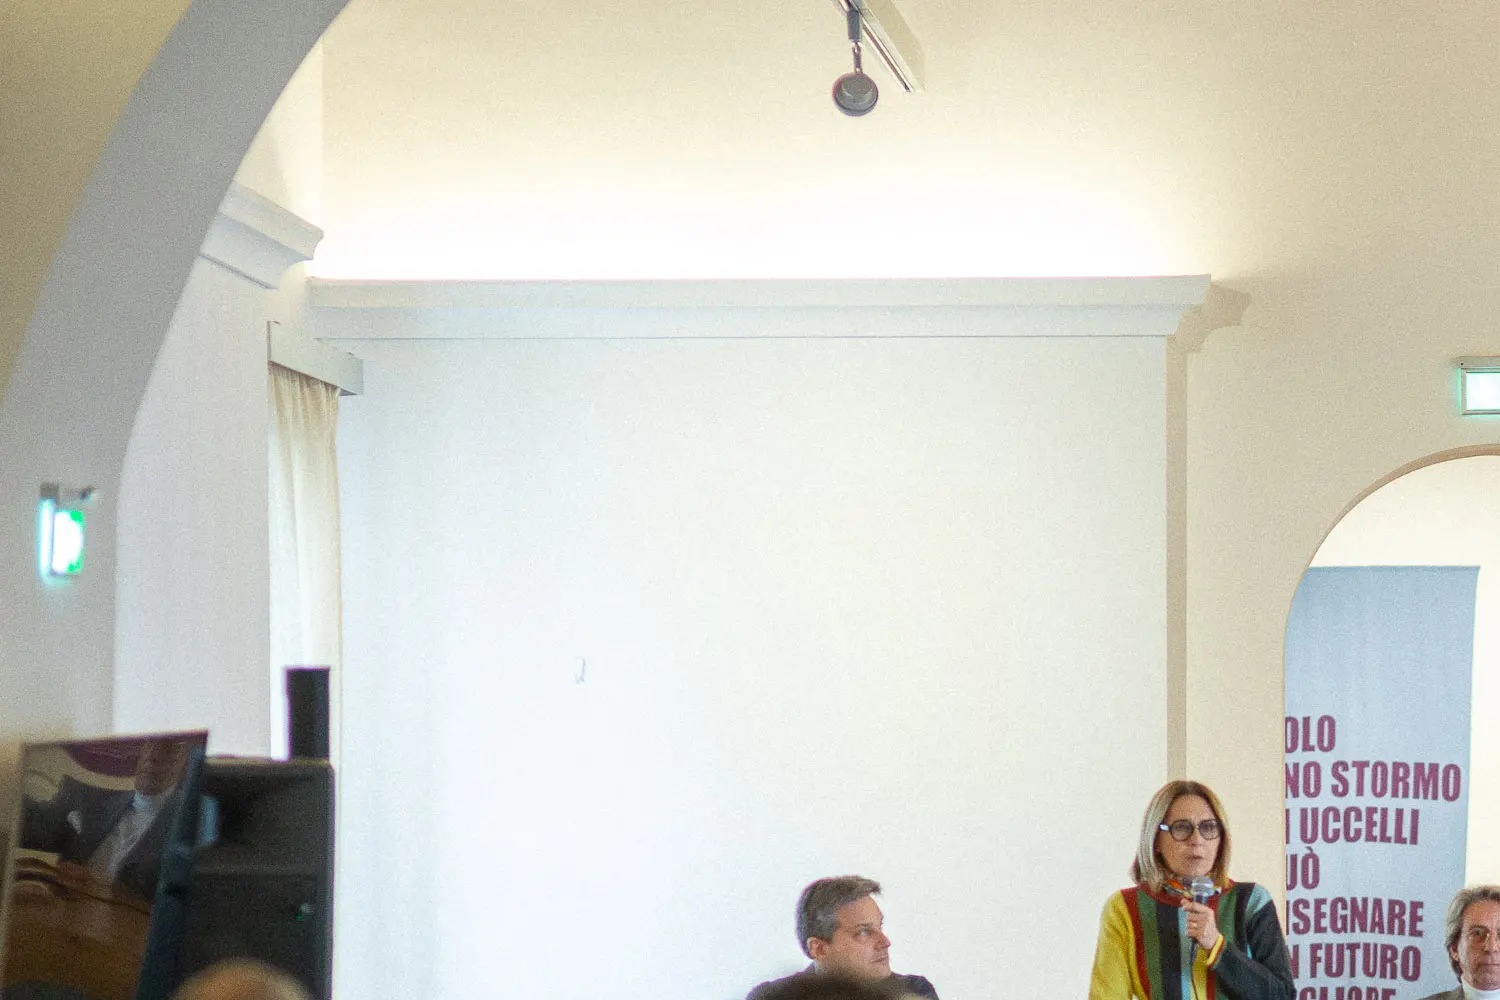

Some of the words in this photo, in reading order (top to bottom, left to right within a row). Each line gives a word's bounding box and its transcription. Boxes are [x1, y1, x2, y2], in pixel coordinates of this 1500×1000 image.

[1285, 715, 1336, 753] OLO
[1285, 761, 1321, 798] NO
[1331, 761, 1461, 801] STORMO
[1300, 806, 1419, 845] UCCELLI
[1310, 942, 1421, 981] FUTURO
